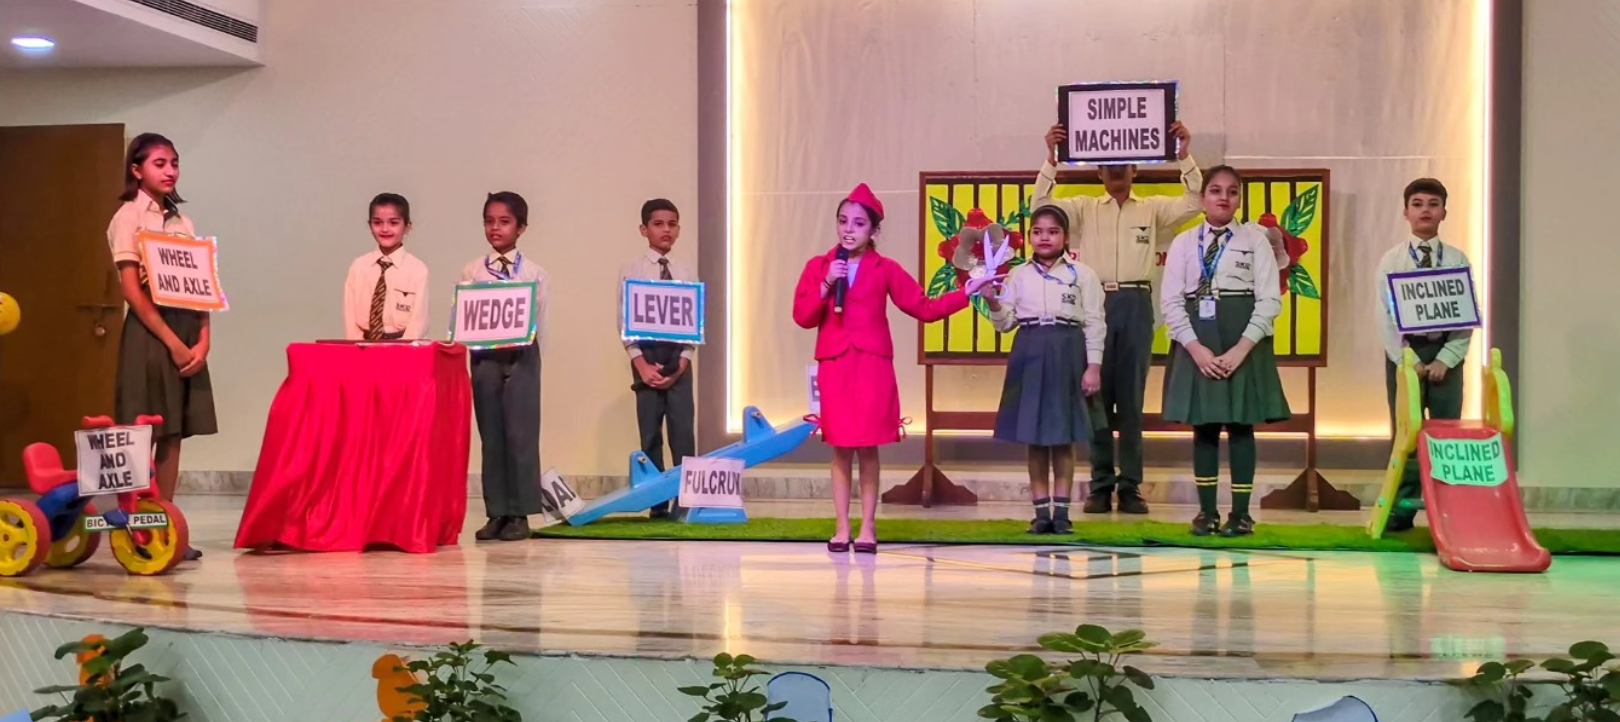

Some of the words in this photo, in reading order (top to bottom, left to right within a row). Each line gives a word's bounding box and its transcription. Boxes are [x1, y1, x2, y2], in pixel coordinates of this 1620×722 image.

[1087, 96, 1147, 120] SIMPLE
[1075, 127, 1160, 152] MACHINES
[157, 246, 198, 269] WHEEL
[157, 273, 180, 293] AND
[183, 277, 212, 296] AXLE
[1400, 278, 1465, 301] INCLINED
[463, 297, 527, 331] WEDGE
[634, 292, 694, 327] LEVER
[1415, 300, 1461, 321] PLANE
[87, 432, 134, 450] WHEEL
[1429, 440, 1500, 461] INCLINED
[100, 452, 126, 470] AND
[98, 470, 133, 490] AXLE
[1442, 464, 1495, 482] PLANE
[133, 515, 166, 525] PEDAL
